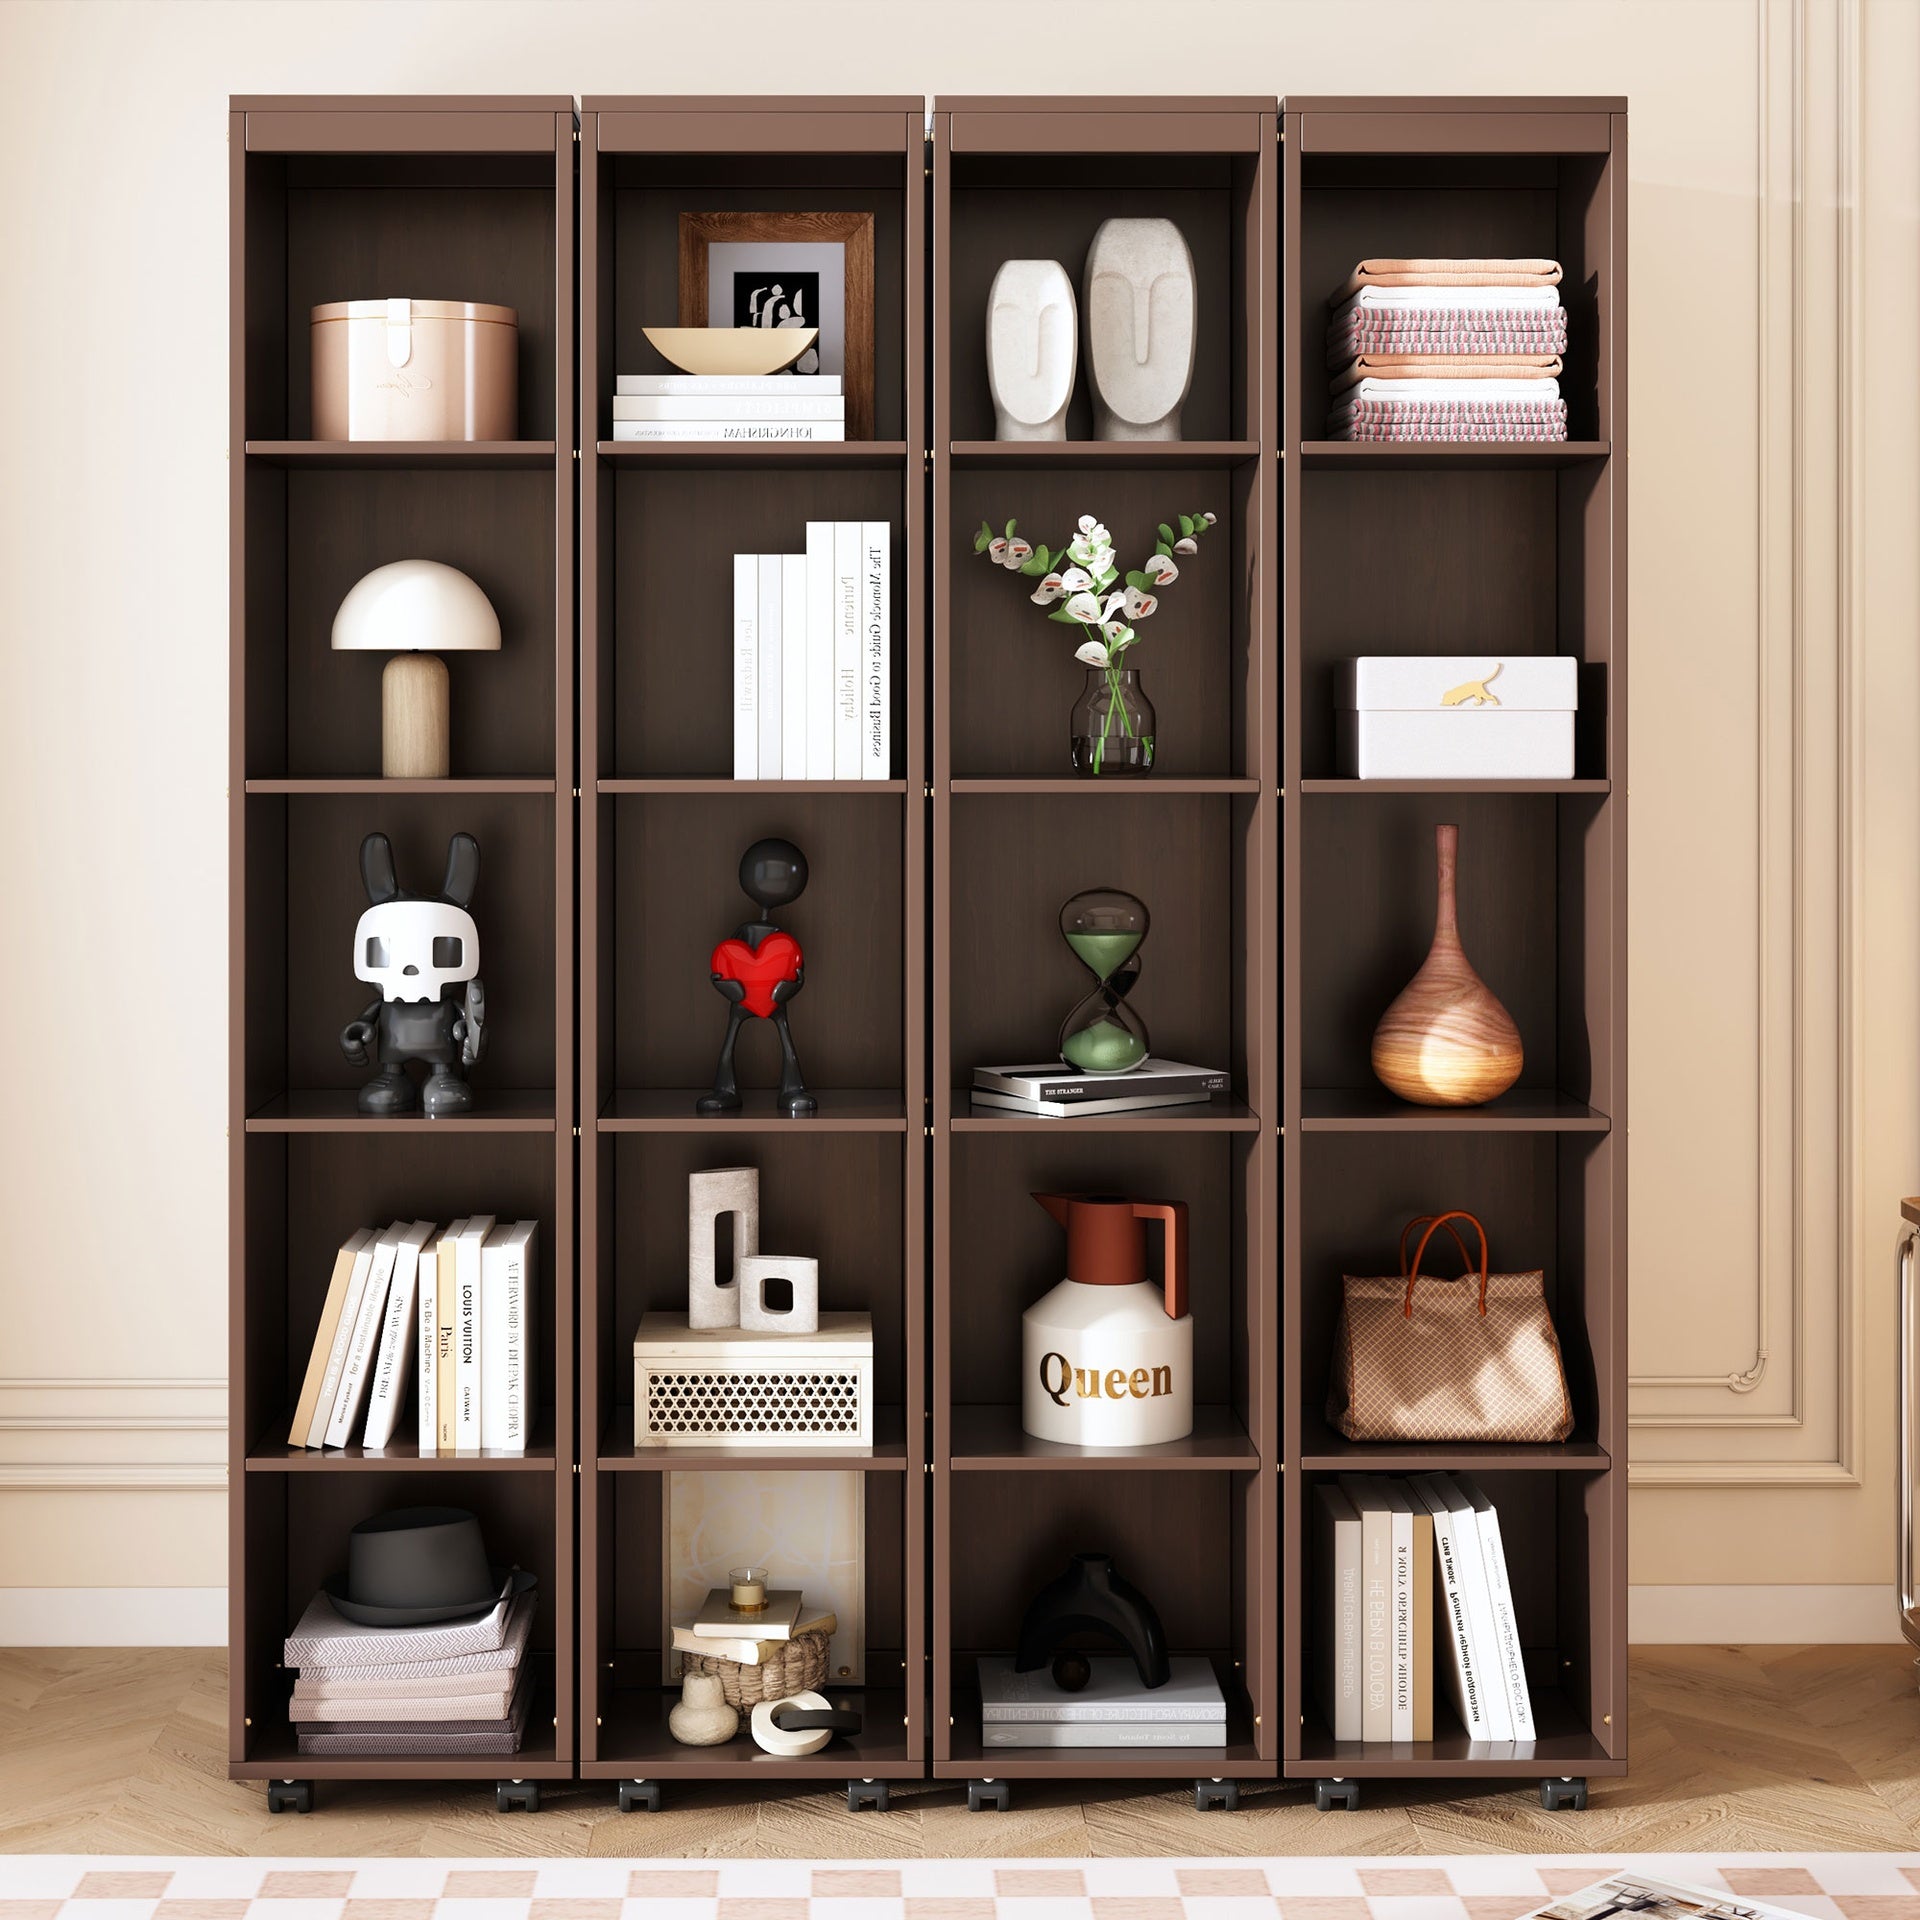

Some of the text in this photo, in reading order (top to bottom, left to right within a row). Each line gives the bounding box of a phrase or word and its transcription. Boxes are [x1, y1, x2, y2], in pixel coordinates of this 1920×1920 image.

[350, 1362, 359, 1375] for
[357, 1302, 375, 1352] sustainable
[369, 1268, 385, 1301] lifestyle
[424, 1297, 432, 1308] To
[424, 1311, 432, 1323] Be
[424, 1334, 432, 1373] Machine
[440, 1326, 452, 1358] Paris
[463, 1285, 472, 1422] LOUIS VUITTON CATWALK
[1040, 1352, 1173, 1407] Queen
